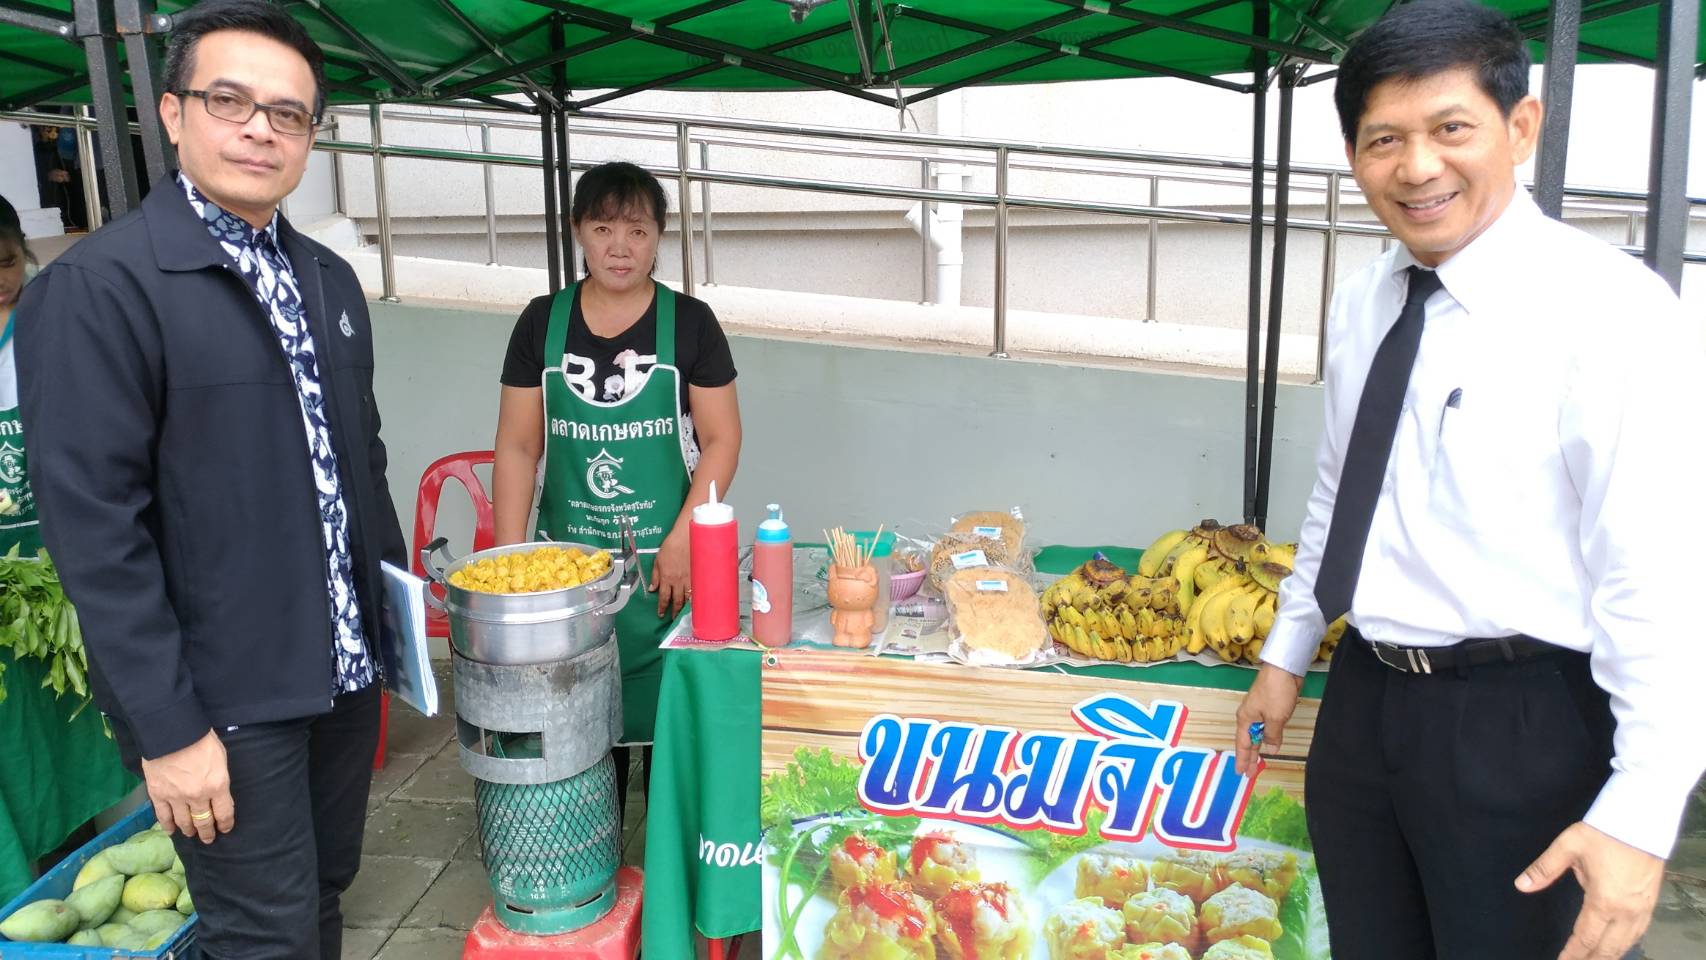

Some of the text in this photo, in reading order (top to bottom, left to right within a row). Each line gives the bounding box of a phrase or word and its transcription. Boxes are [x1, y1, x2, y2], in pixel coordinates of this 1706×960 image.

[551, 417, 674, 442] ตลาดเกษตรกร
[857, 693, 1262, 851] ขนมจีบ
[698, 832, 763, 868] าดน
